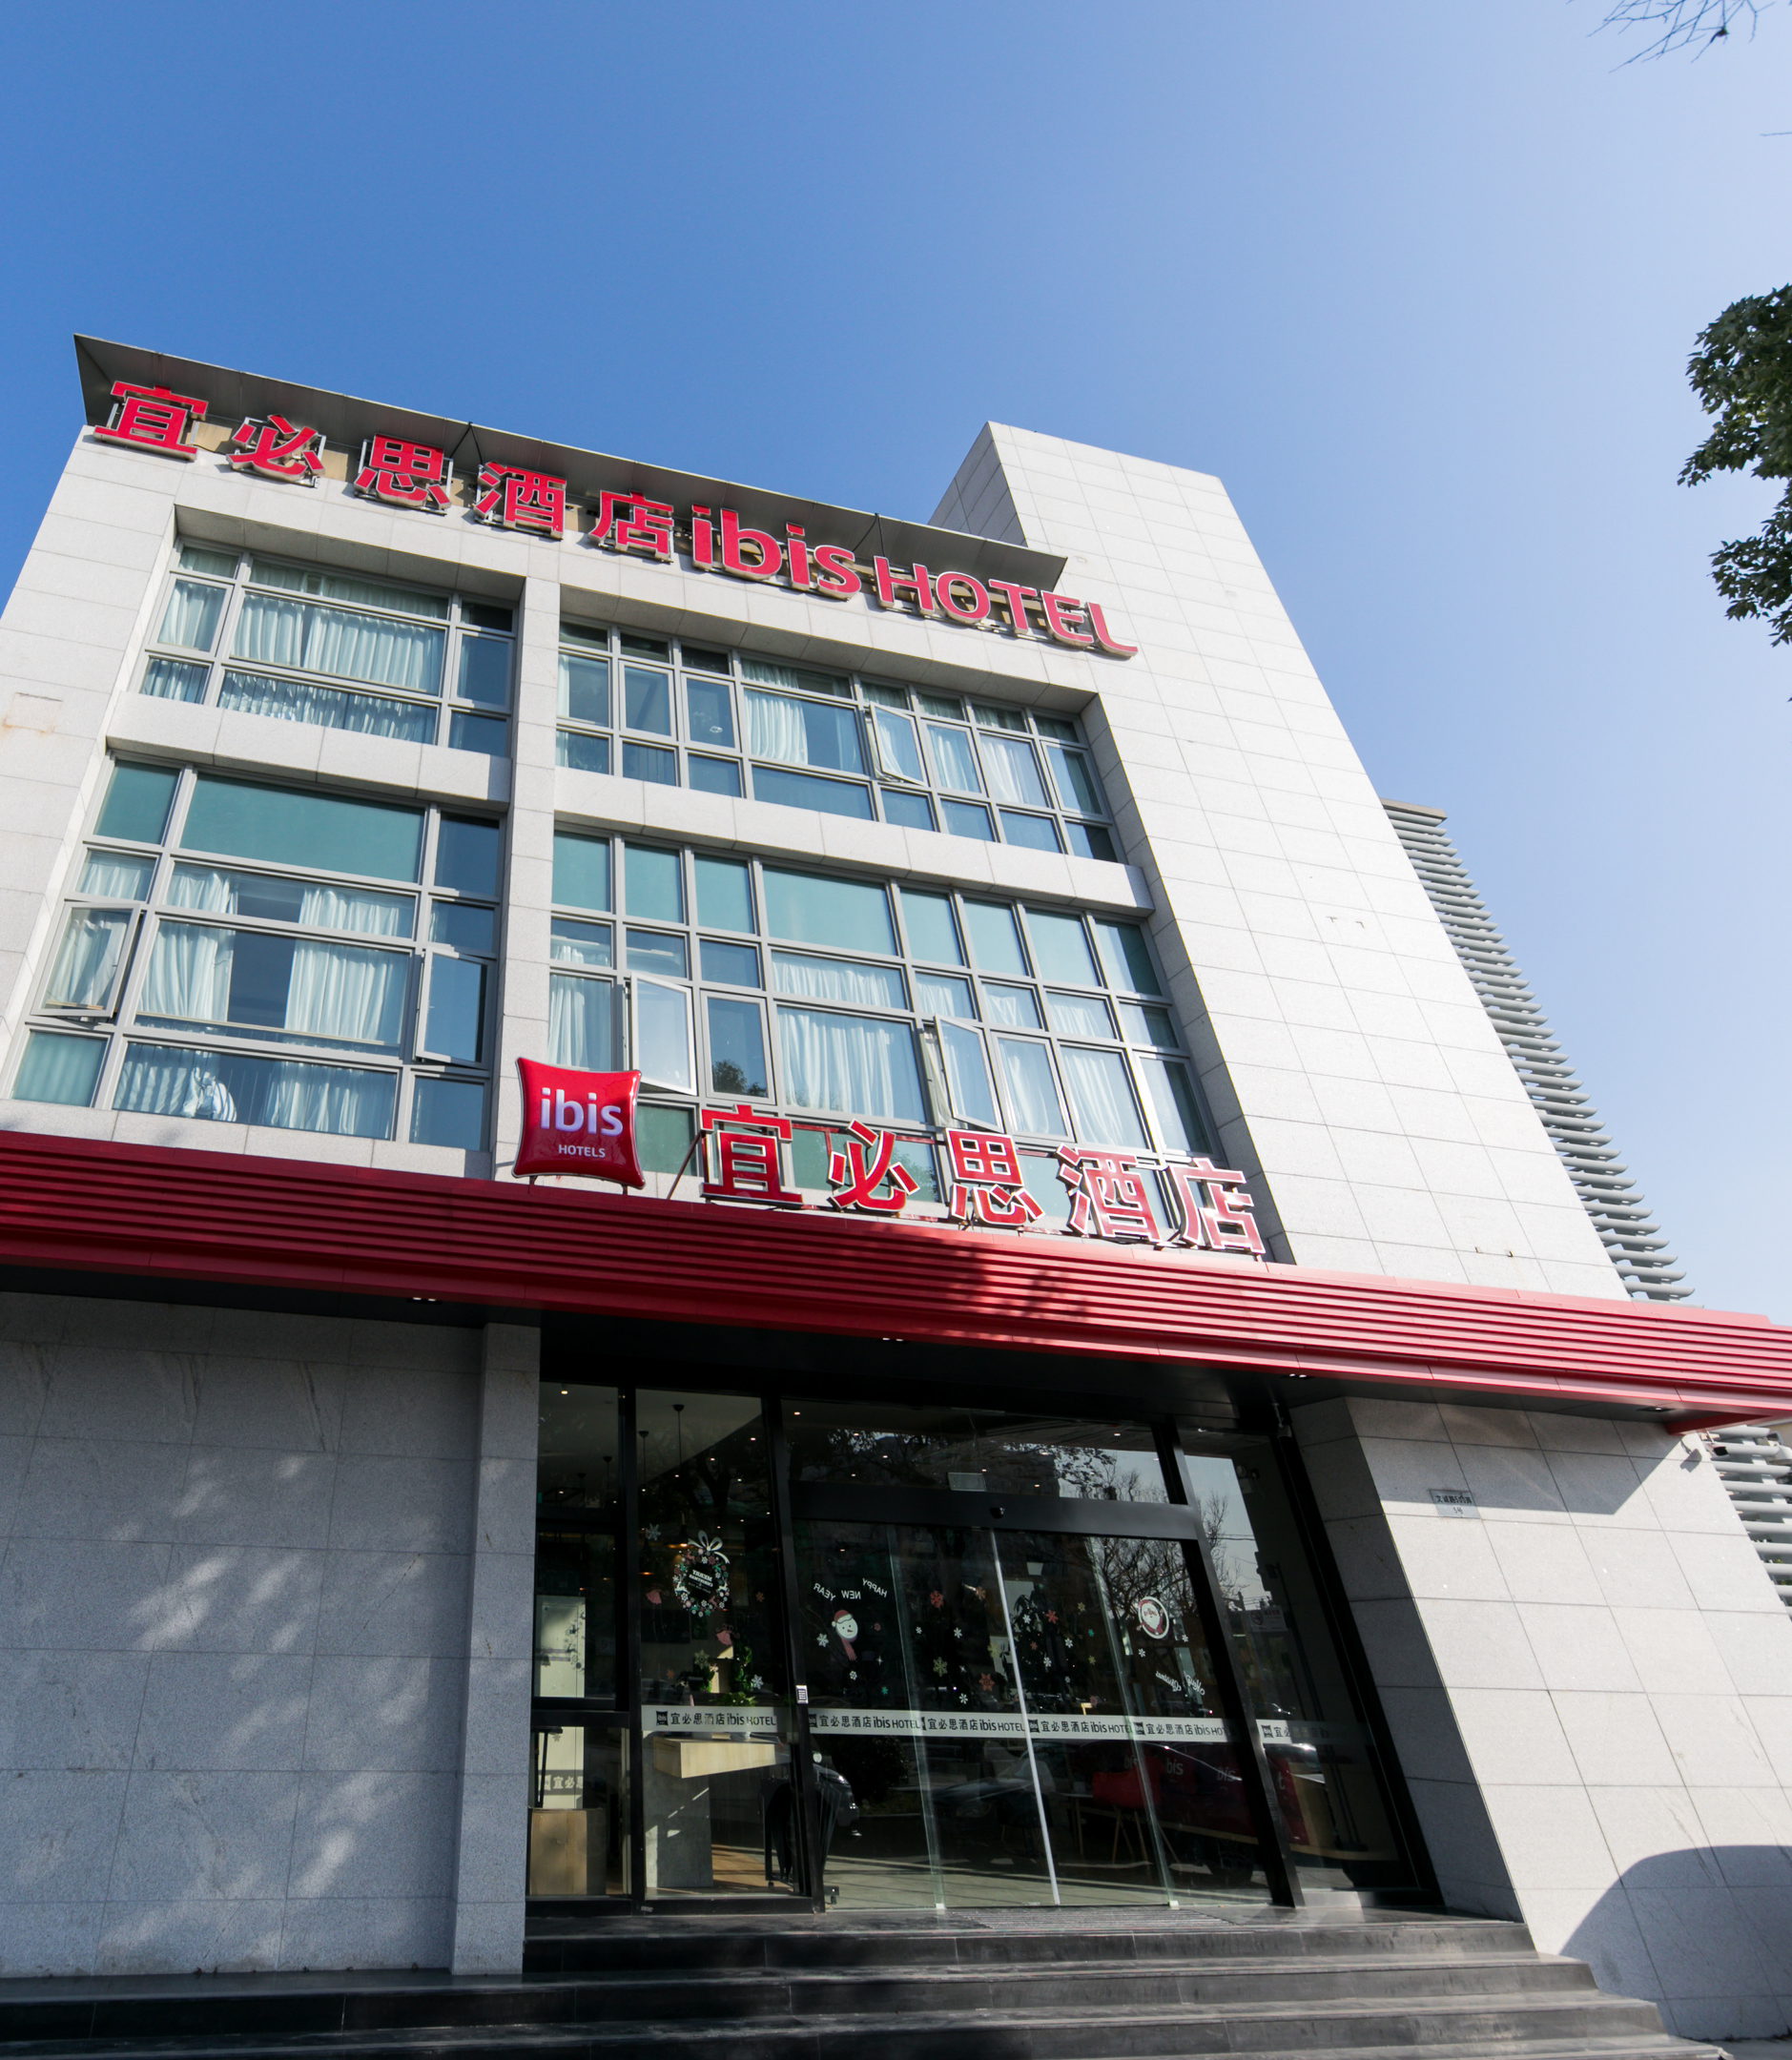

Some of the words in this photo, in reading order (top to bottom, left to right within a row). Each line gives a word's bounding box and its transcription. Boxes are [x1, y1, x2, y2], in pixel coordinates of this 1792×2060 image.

[93, 380, 673, 564] 宜必思酒店
[691, 504, 862, 602] ibis
[873, 555, 1139, 659] HOTEL
[540, 1087, 624, 1137] ibis
[558, 1144, 607, 1159] HOTELS
[700, 1103, 1267, 1255] 宜必思酒店
[670, 1713, 725, 1725] 宜必思酒店
[727, 1713, 745, 1725] ibis
[747, 1716, 776, 1726] HOTEL
[819, 1715, 872, 1728] 宜必思酒店
[873, 1716, 891, 1729] ibis
[892, 1719, 921, 1729] HOTEL
[927, 1718, 978, 1731] 宜必思酒店
[979, 1719, 997, 1731] ibis
[998, 1721, 1025, 1732] HOTEL
[1040, 1720, 1090, 1733] 宜必思酒店
[1090, 1720, 1107, 1733] ibis
[1145, 1722, 1193, 1736] 宜必思酒店
[1194, 1724, 1210, 1736] ibis
